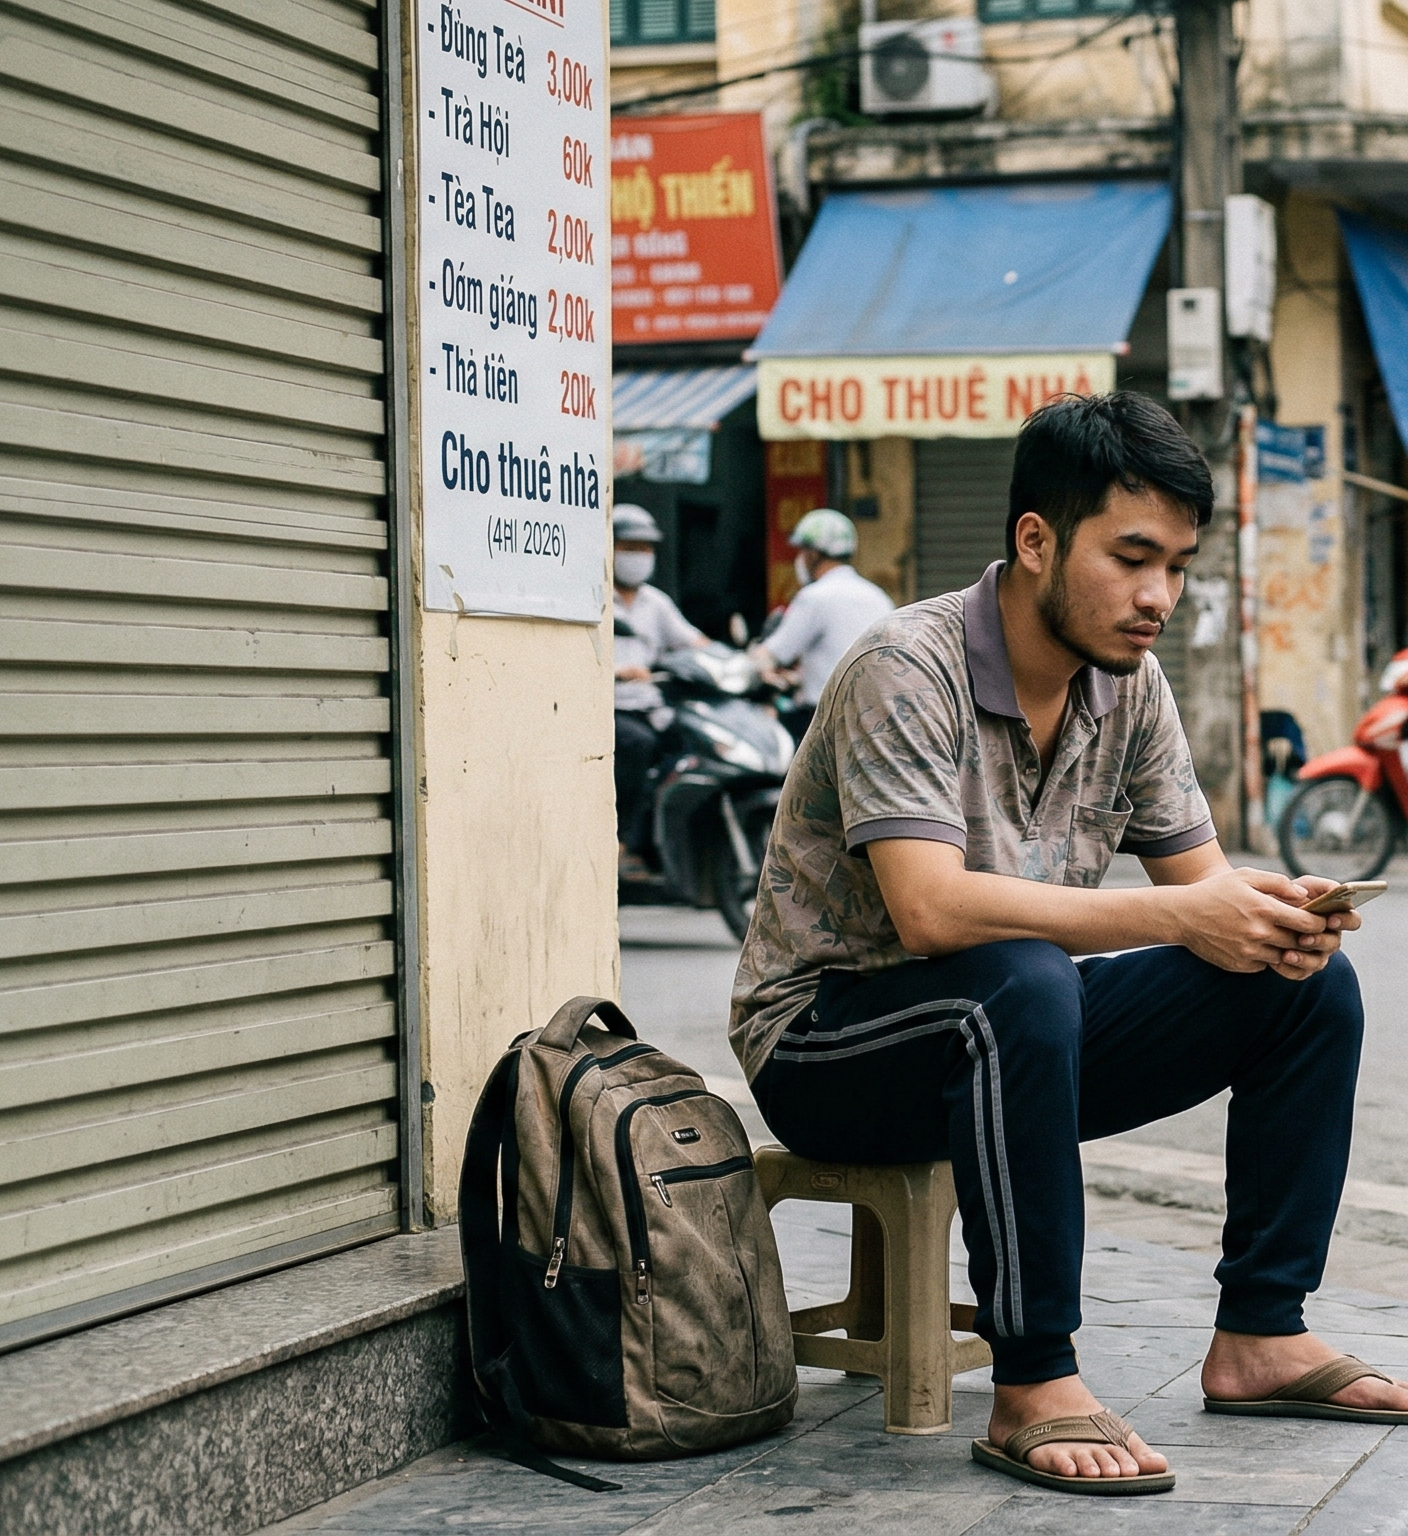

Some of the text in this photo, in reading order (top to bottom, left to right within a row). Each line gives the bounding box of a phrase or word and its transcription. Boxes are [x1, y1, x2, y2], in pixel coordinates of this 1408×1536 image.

[548, 51, 592, 111] 3,00k
[441, 87, 473, 145] Trà
[563, 136, 593, 188] 60k
[441, 172, 476, 230] Tèa
[482, 185, 515, 242] Tea
[548, 209, 594, 265] 2,00k
[490, 274, 538, 340] giáng
[548, 289, 594, 343] 2,00k
[484, 353, 518, 404] tiên
[779, 378, 862, 422] CHO
[881, 365, 986, 421] THUÊ
[442, 430, 599, 509] Cho thuê nhà
[523, 520, 566, 567] 2026)
